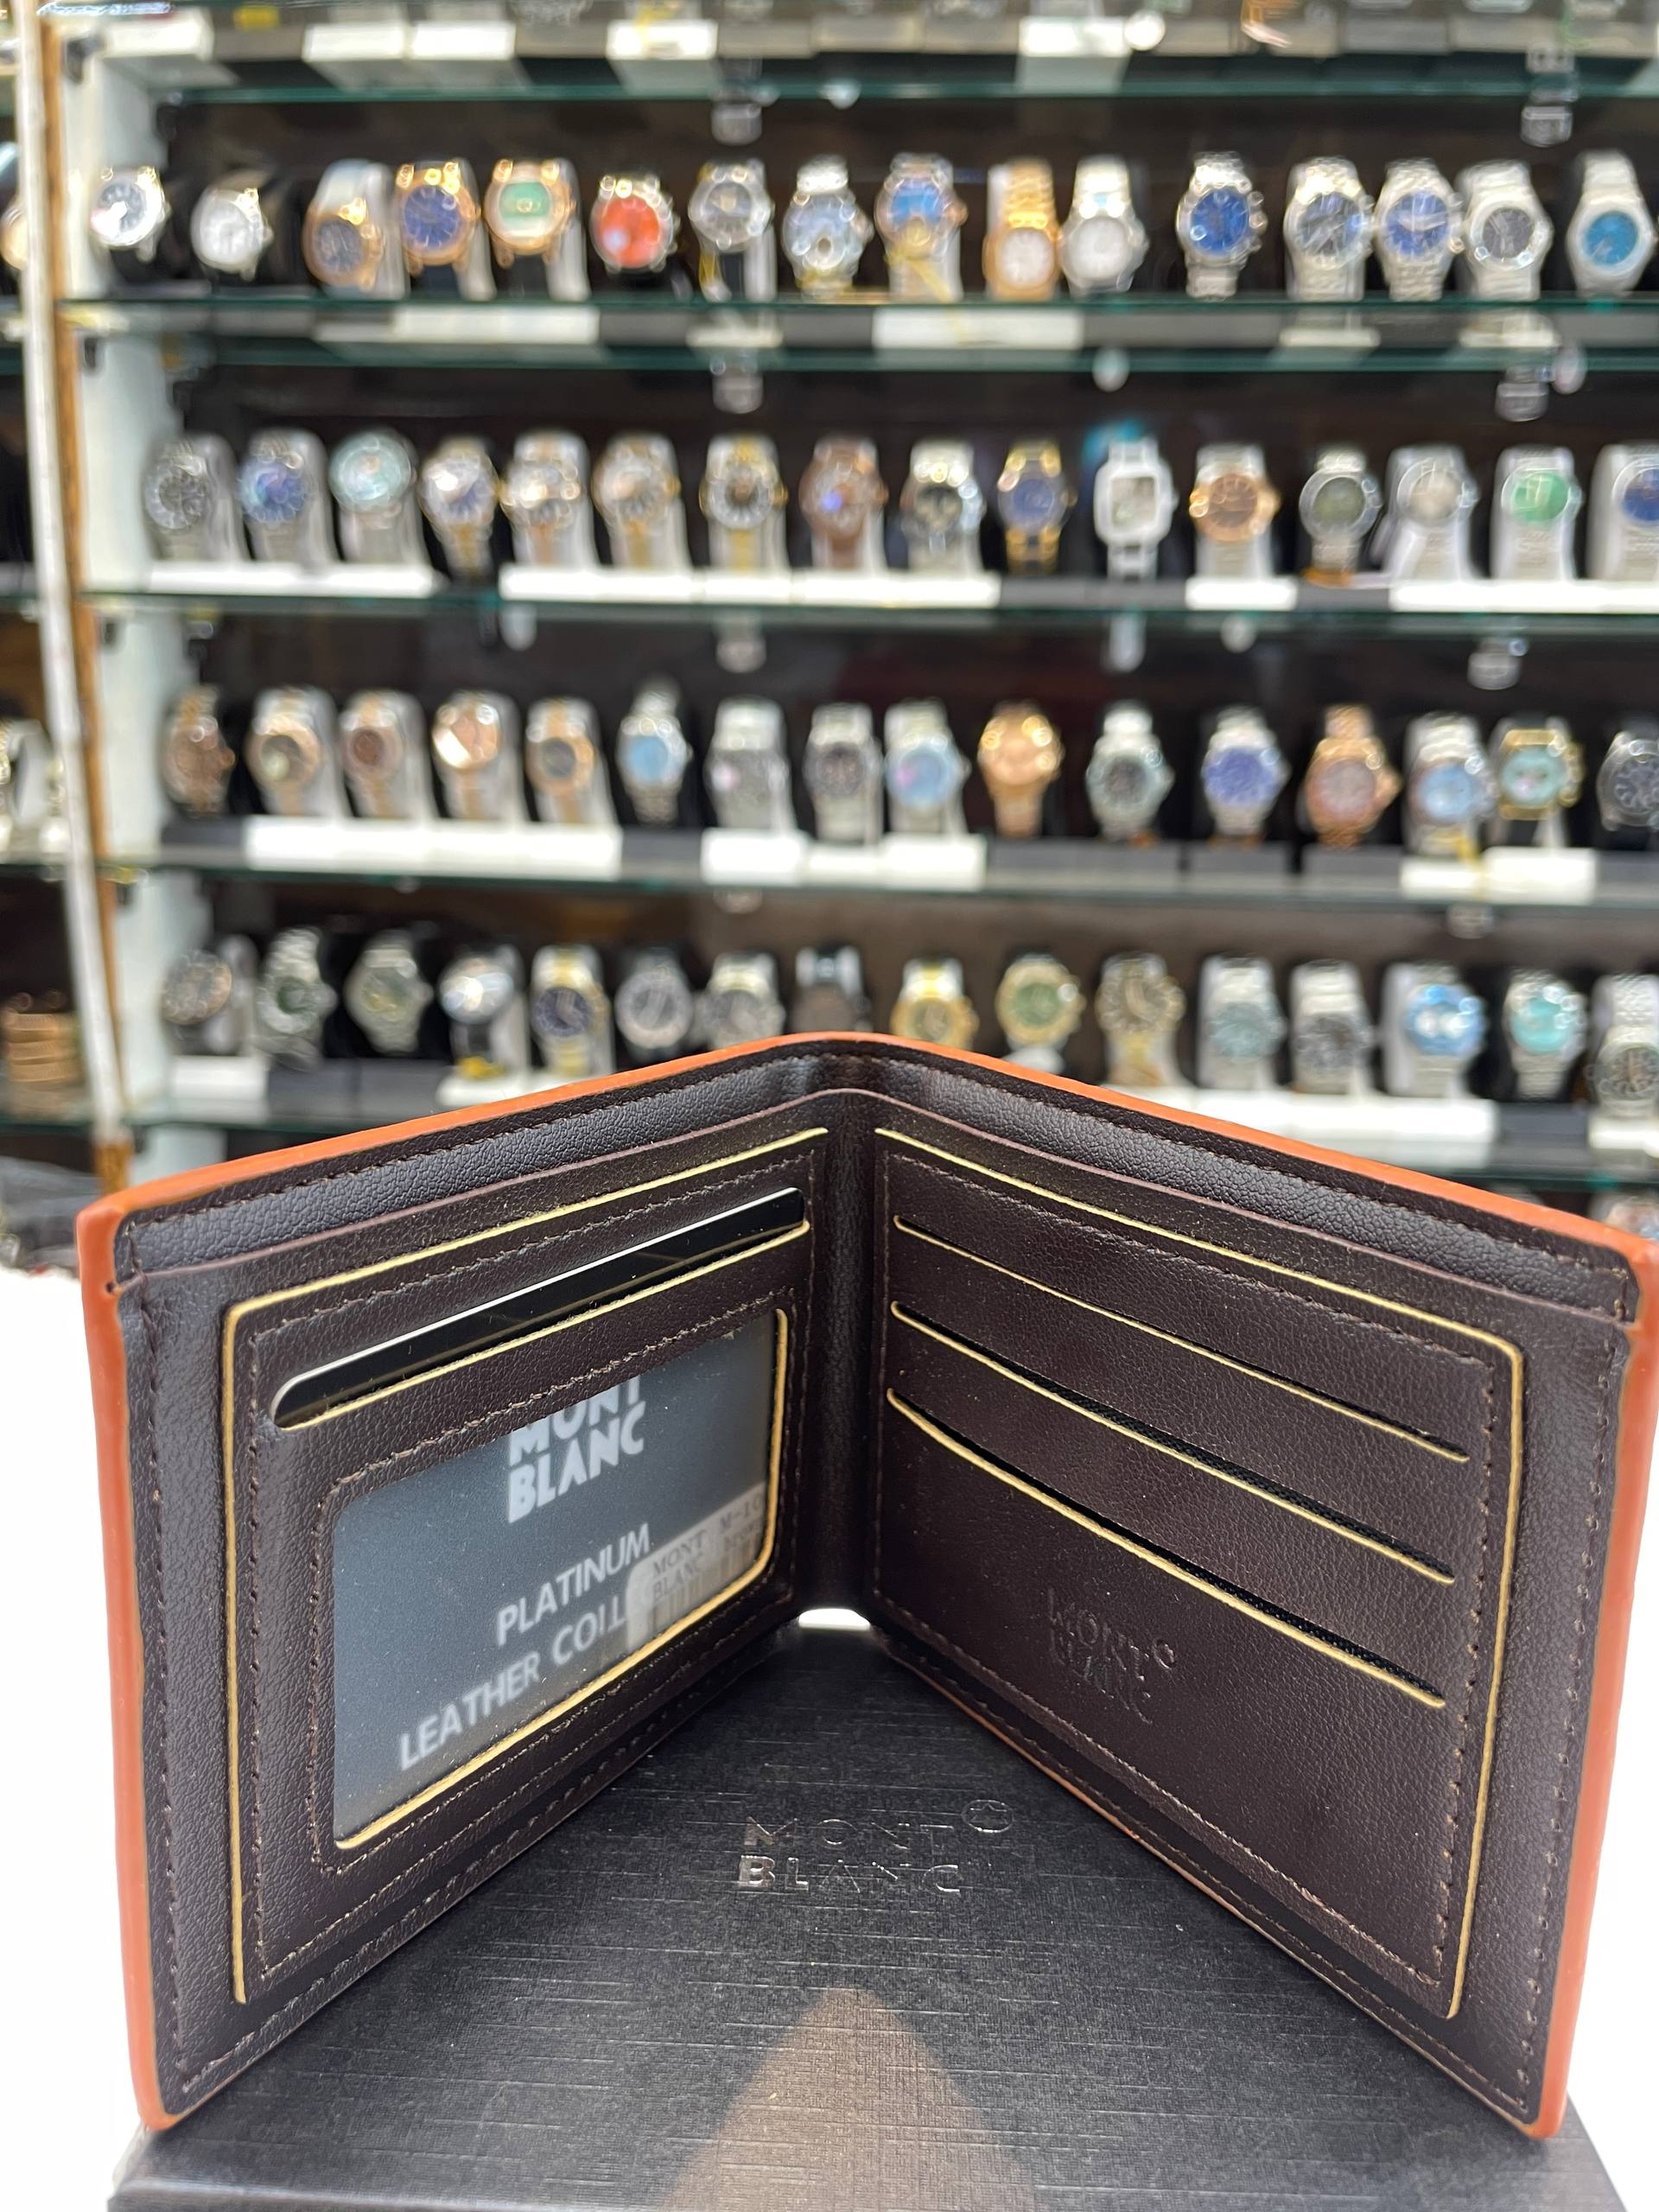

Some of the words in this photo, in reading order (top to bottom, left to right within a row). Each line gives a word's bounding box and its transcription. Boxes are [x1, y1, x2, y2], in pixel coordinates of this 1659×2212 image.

[508, 1401, 646, 1523] BLANC
[497, 1522, 650, 1646] PLATINUM
[653, 1529, 706, 1576] MONT
[400, 1651, 541, 1770] LEATHER
[551, 1596, 629, 1666] COLL
[738, 1854, 961, 1894] BLANC
[744, 1816, 955, 1856] MONT
